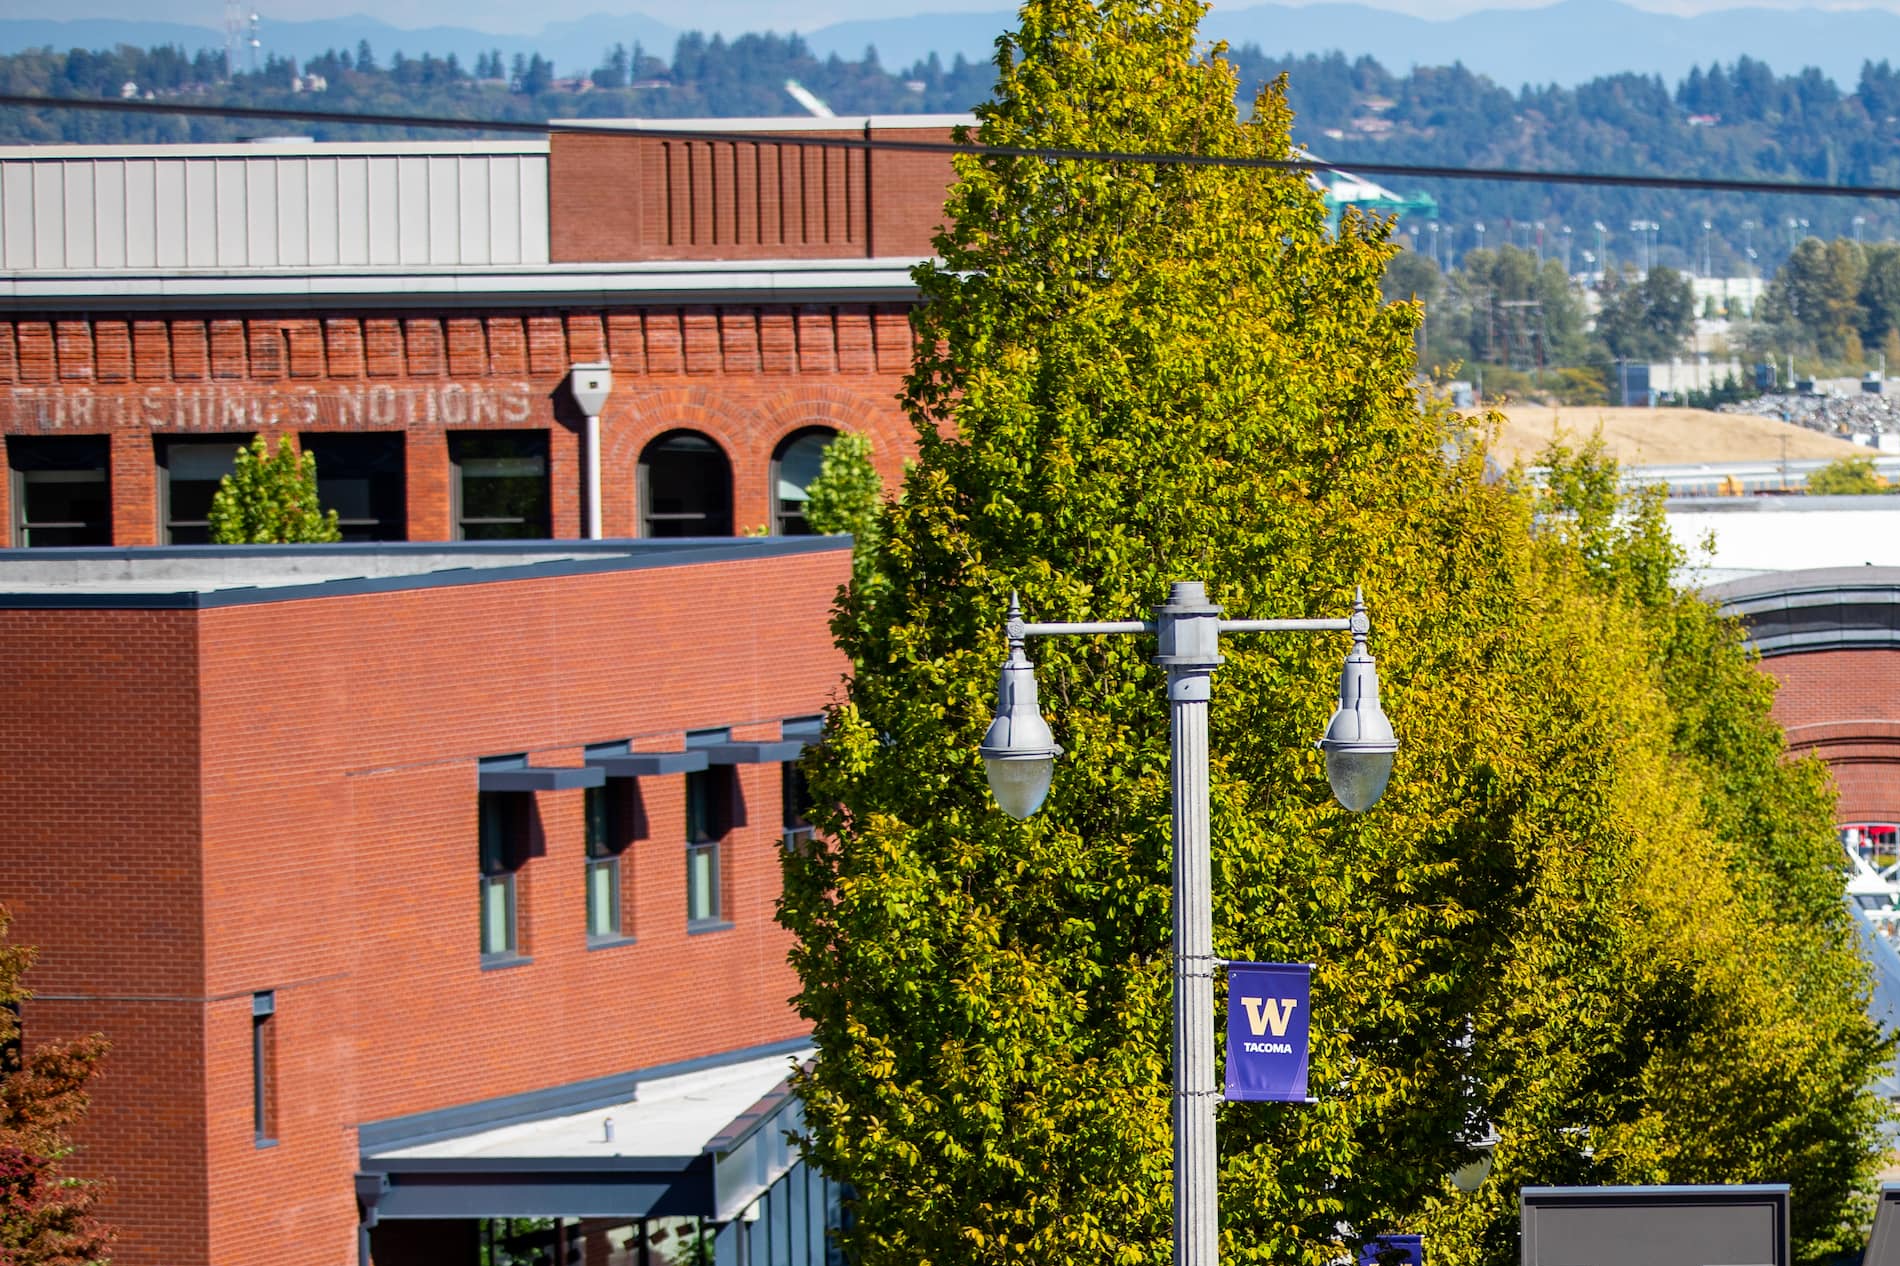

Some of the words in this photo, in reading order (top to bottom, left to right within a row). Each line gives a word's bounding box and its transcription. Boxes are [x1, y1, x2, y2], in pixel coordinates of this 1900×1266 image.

[338, 383, 531, 424] NOTIONS
[1241, 997, 1297, 1036] W
[1244, 1042, 1292, 1054] TACOMA
